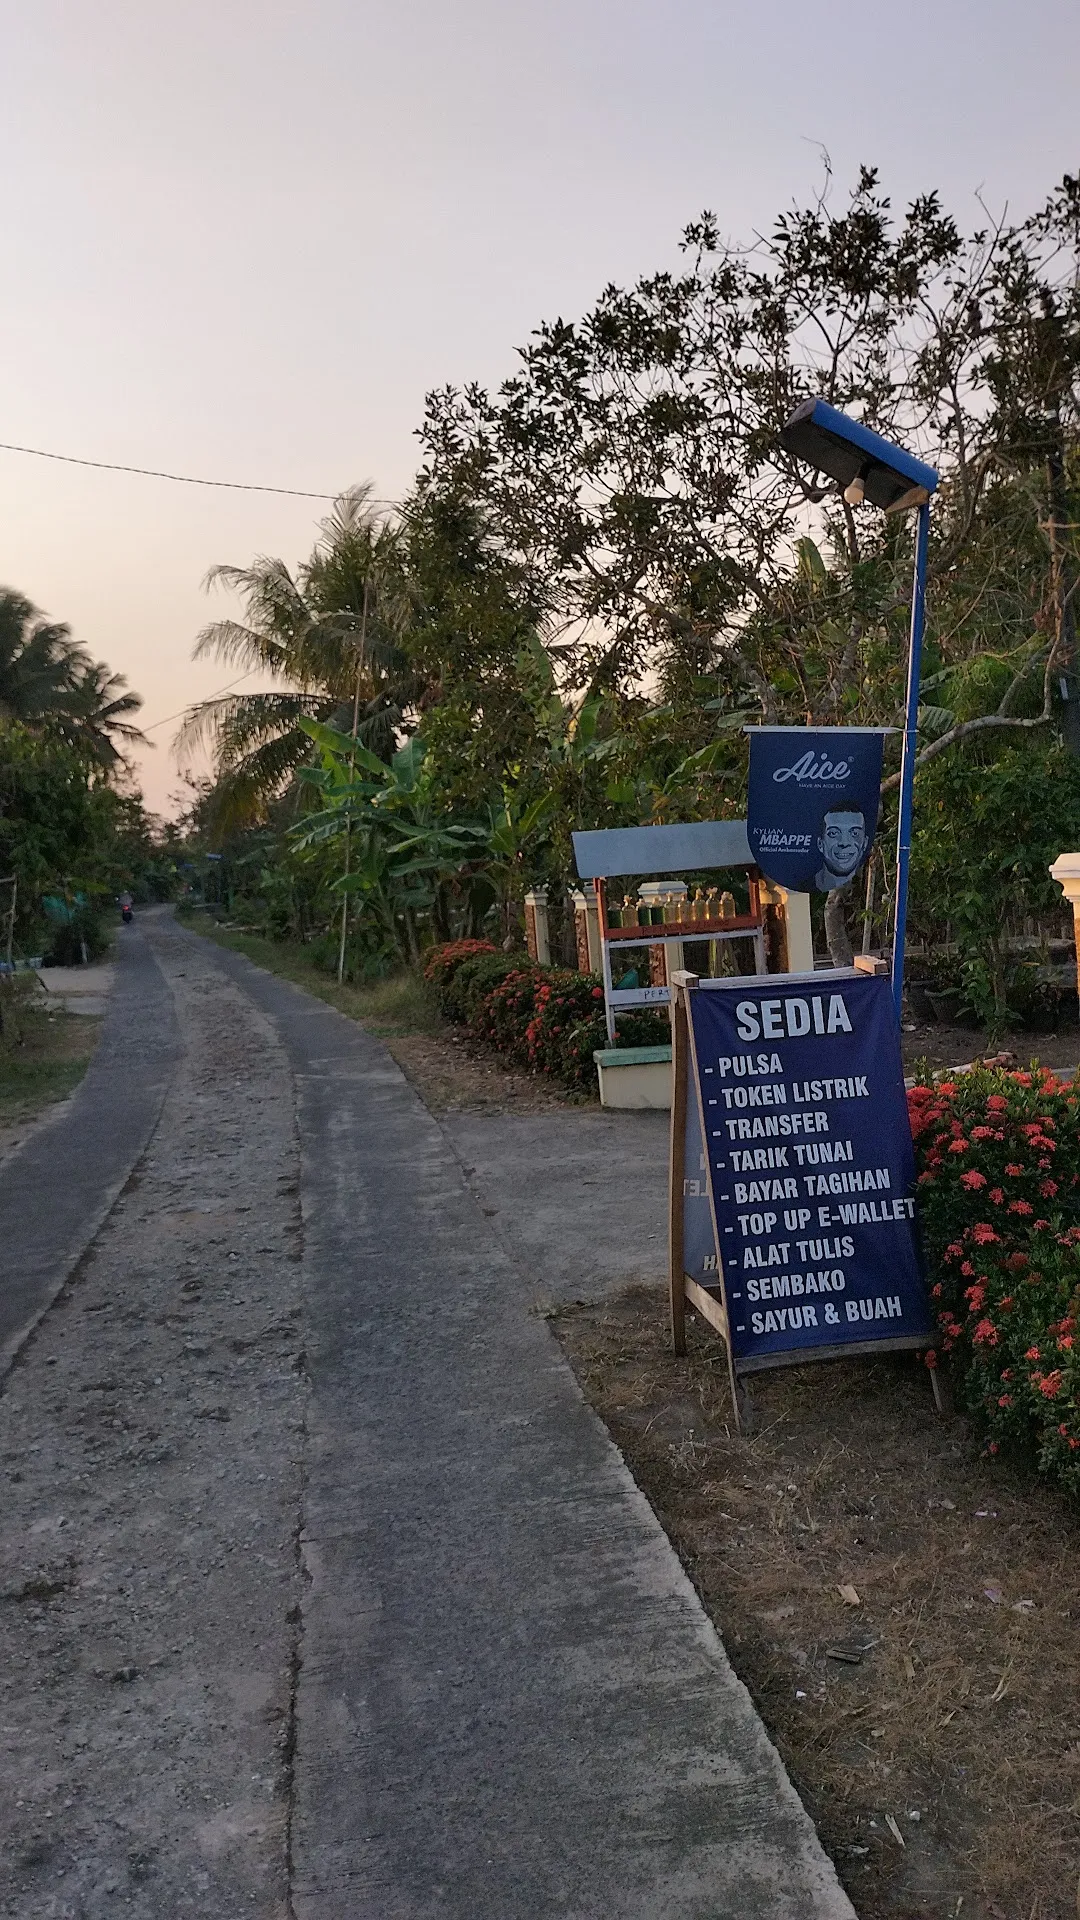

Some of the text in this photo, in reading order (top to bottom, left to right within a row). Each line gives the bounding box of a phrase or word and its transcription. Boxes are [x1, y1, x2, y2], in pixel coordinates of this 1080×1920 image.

[772, 750, 851, 783] Aice
[753, 827, 784, 835] KYLIAN
[759, 834, 812, 846] MBAPPE
[735, 994, 853, 1042] SEDIA
[792, 1076, 870, 1103] LISTRIK
[792, 1140, 854, 1166] TUNAI
[803, 1168, 891, 1197] TAGIHAN
[783, 1208, 812, 1232] UP
[817, 1197, 916, 1228] E-WALLET
[796, 1235, 855, 1263] TULIS
[824, 1302, 841, 1325] &
[845, 1296, 902, 1322] BUAH
